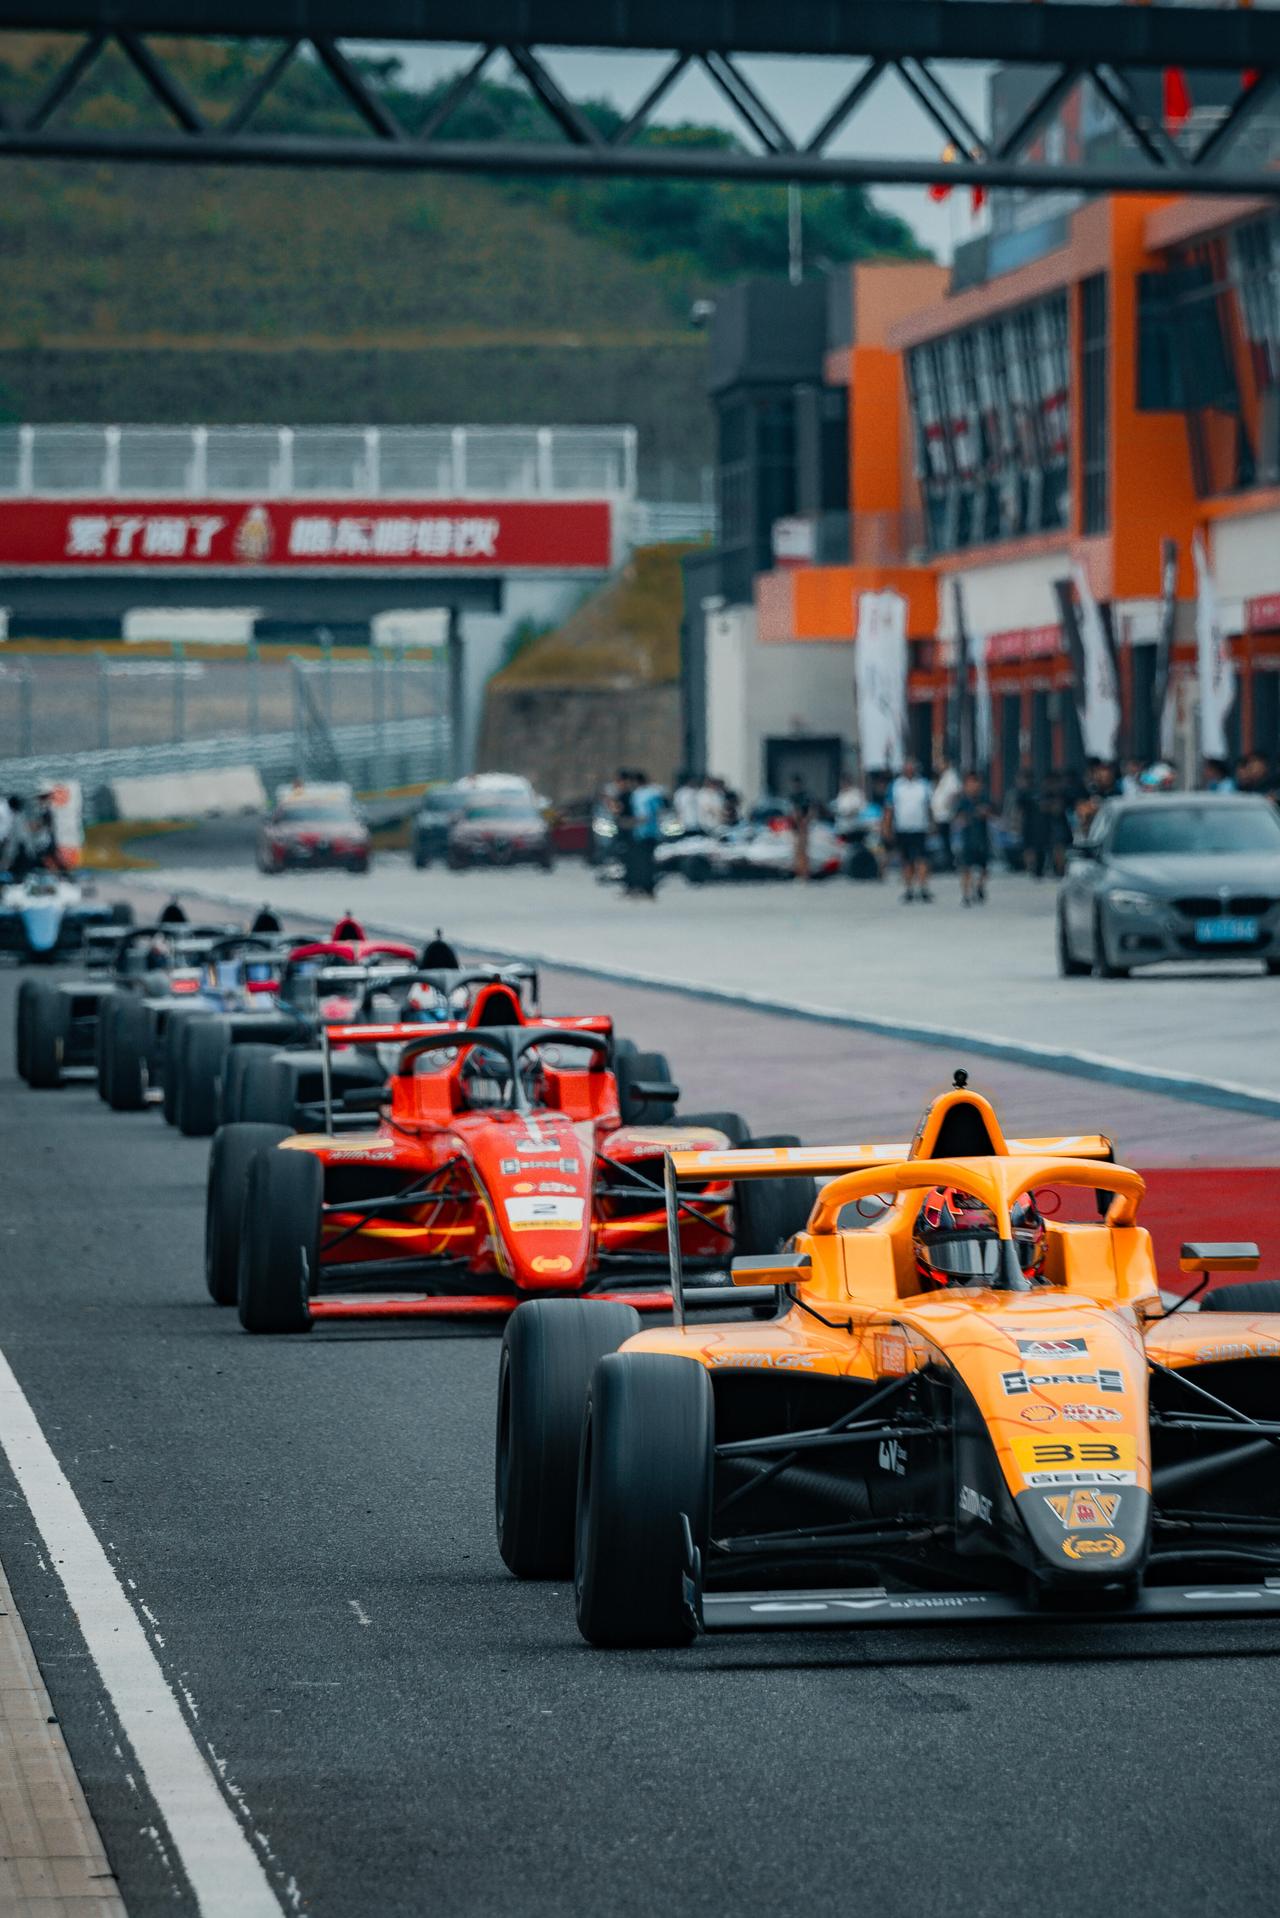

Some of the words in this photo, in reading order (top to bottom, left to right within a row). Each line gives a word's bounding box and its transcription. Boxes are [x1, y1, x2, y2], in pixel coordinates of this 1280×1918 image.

[532, 1203, 558, 1215] 2
[1000, 1369, 1124, 1395] HORSE
[1032, 1443, 1121, 1463] 33
[1031, 1472, 1128, 1484] GEELY
